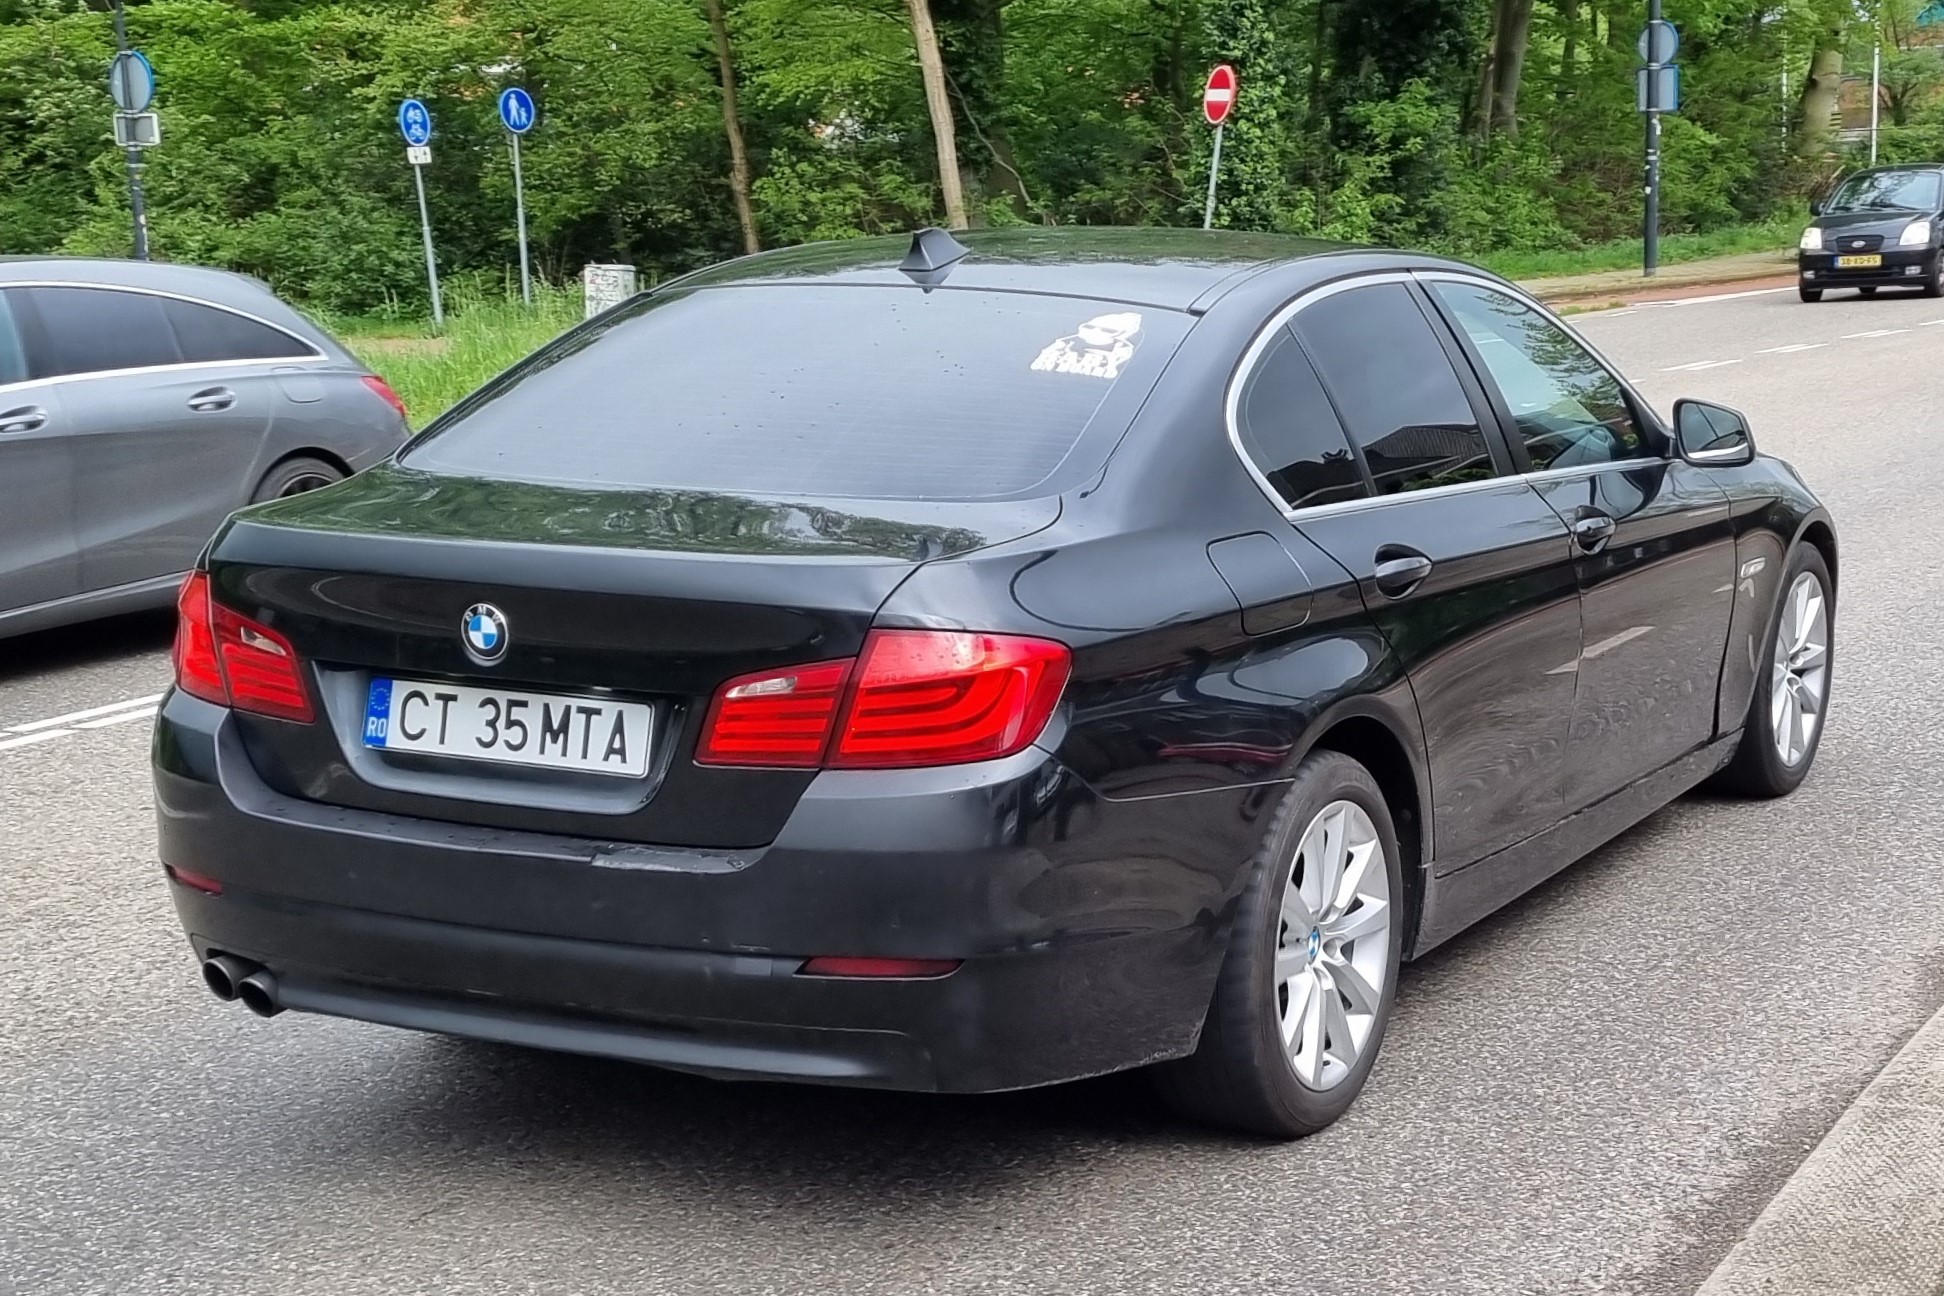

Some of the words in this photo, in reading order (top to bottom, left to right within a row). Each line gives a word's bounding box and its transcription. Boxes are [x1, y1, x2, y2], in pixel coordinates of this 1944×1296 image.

[465, 605, 502, 625] BMW
[366, 716, 387, 738] RO
[399, 689, 459, 746] CT
[475, 697, 529, 752] 35
[539, 702, 628, 764] MTA
